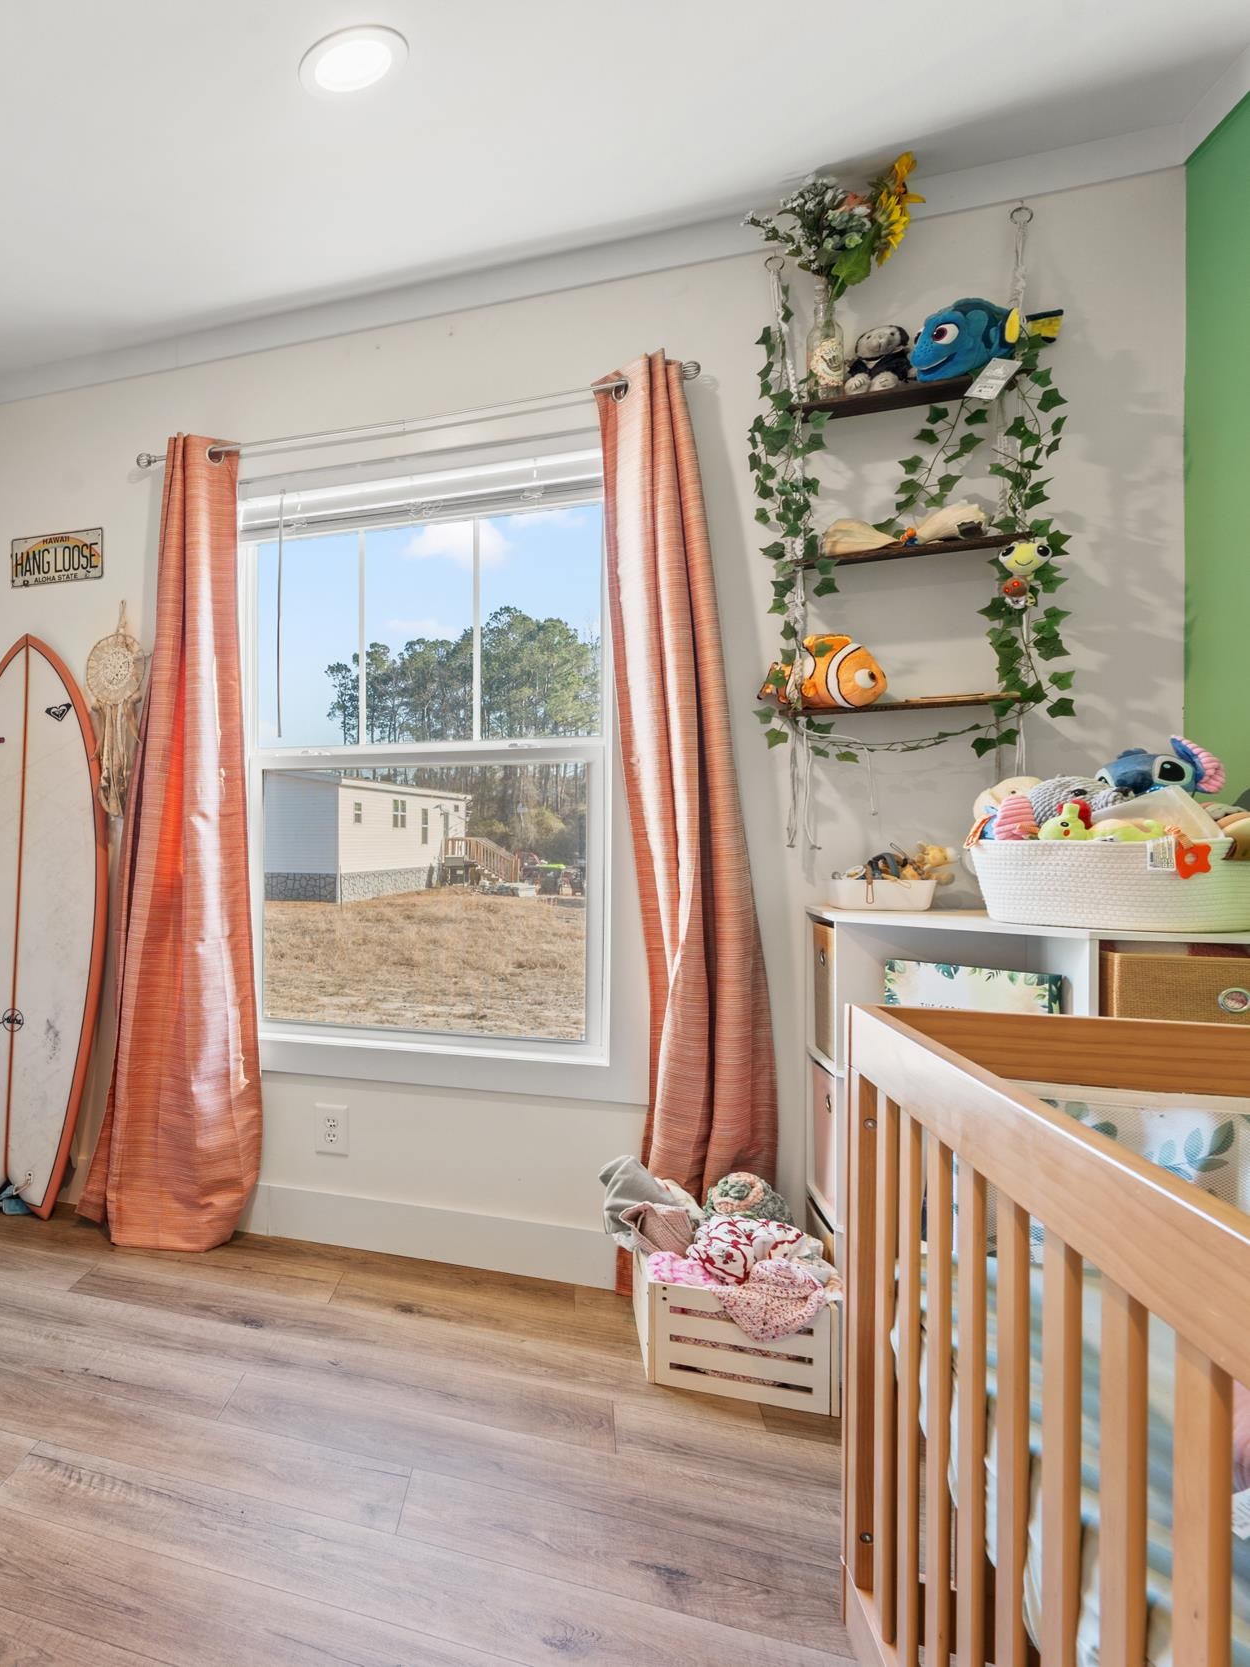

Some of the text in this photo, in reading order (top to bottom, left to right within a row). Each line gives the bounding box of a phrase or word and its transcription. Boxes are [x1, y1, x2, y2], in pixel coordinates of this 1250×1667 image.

[42, 535, 70, 545] HAWAII
[15, 542, 99, 578] HANG LOOSE
[34, 572, 79, 584] ALOHA STATE
